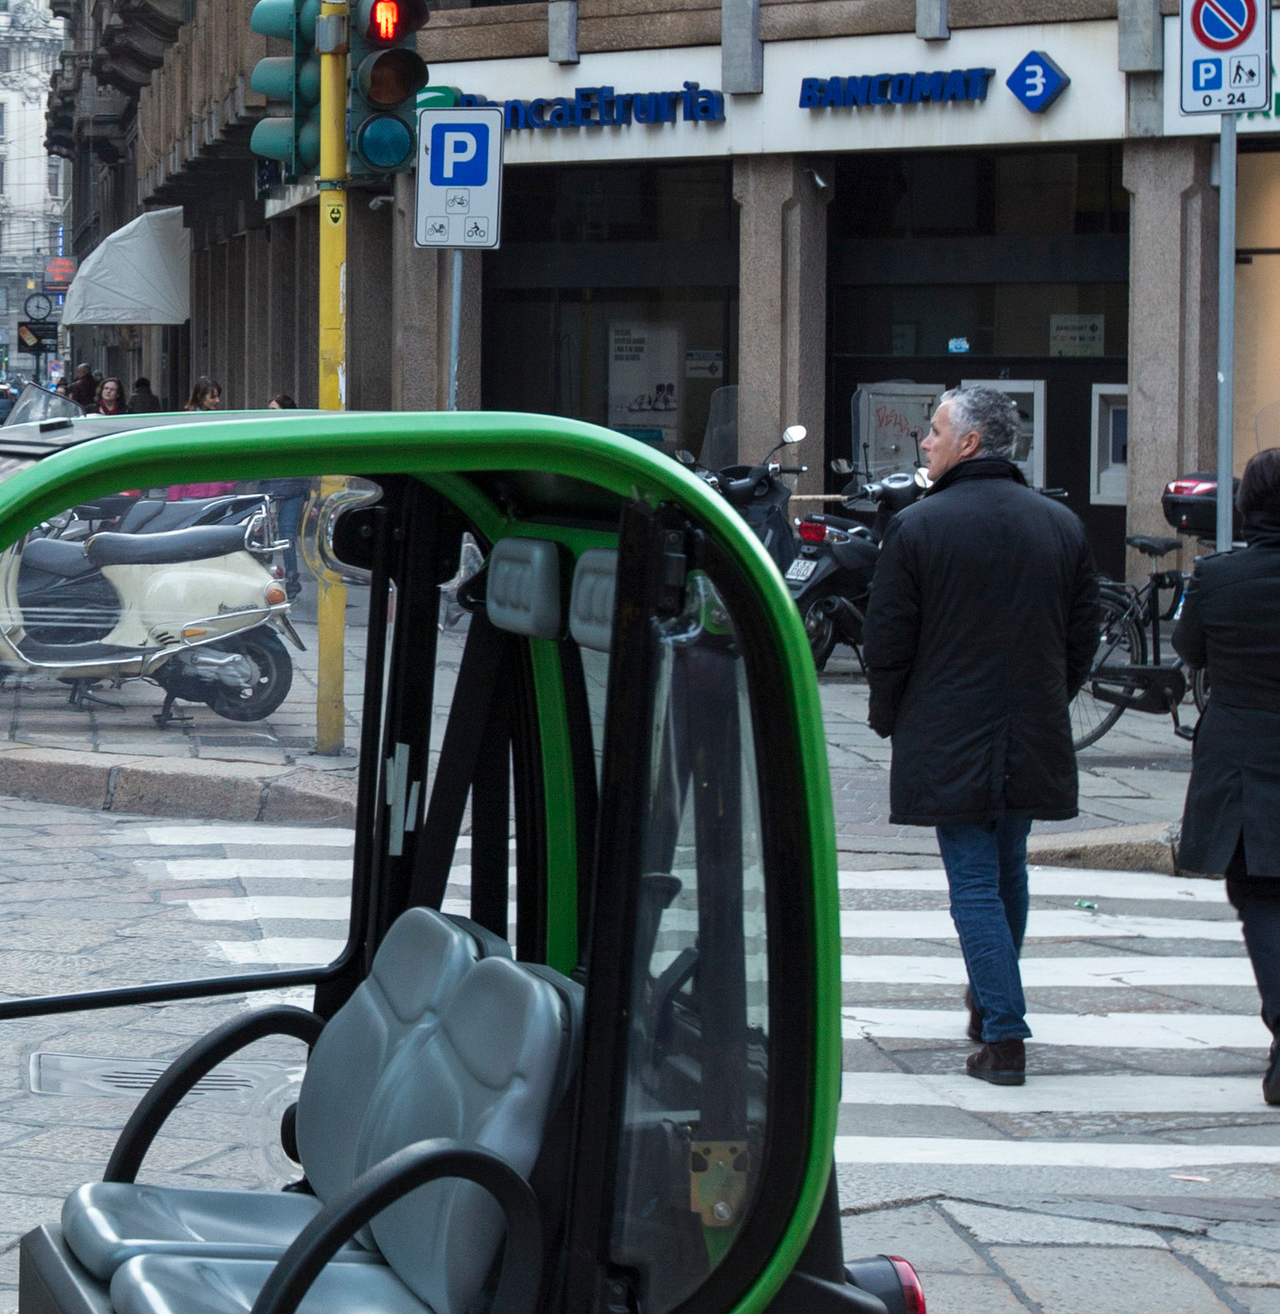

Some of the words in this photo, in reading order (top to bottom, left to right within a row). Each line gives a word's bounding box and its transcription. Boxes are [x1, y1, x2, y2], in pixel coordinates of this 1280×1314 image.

[799, 68, 996, 109] BANCOMAT
[1199, 62, 1217, 88] P
[460, 82, 726, 130] ncaEtruria
[1227, 92, 1246, 105] 24
[443, 131, 477, 178] P
